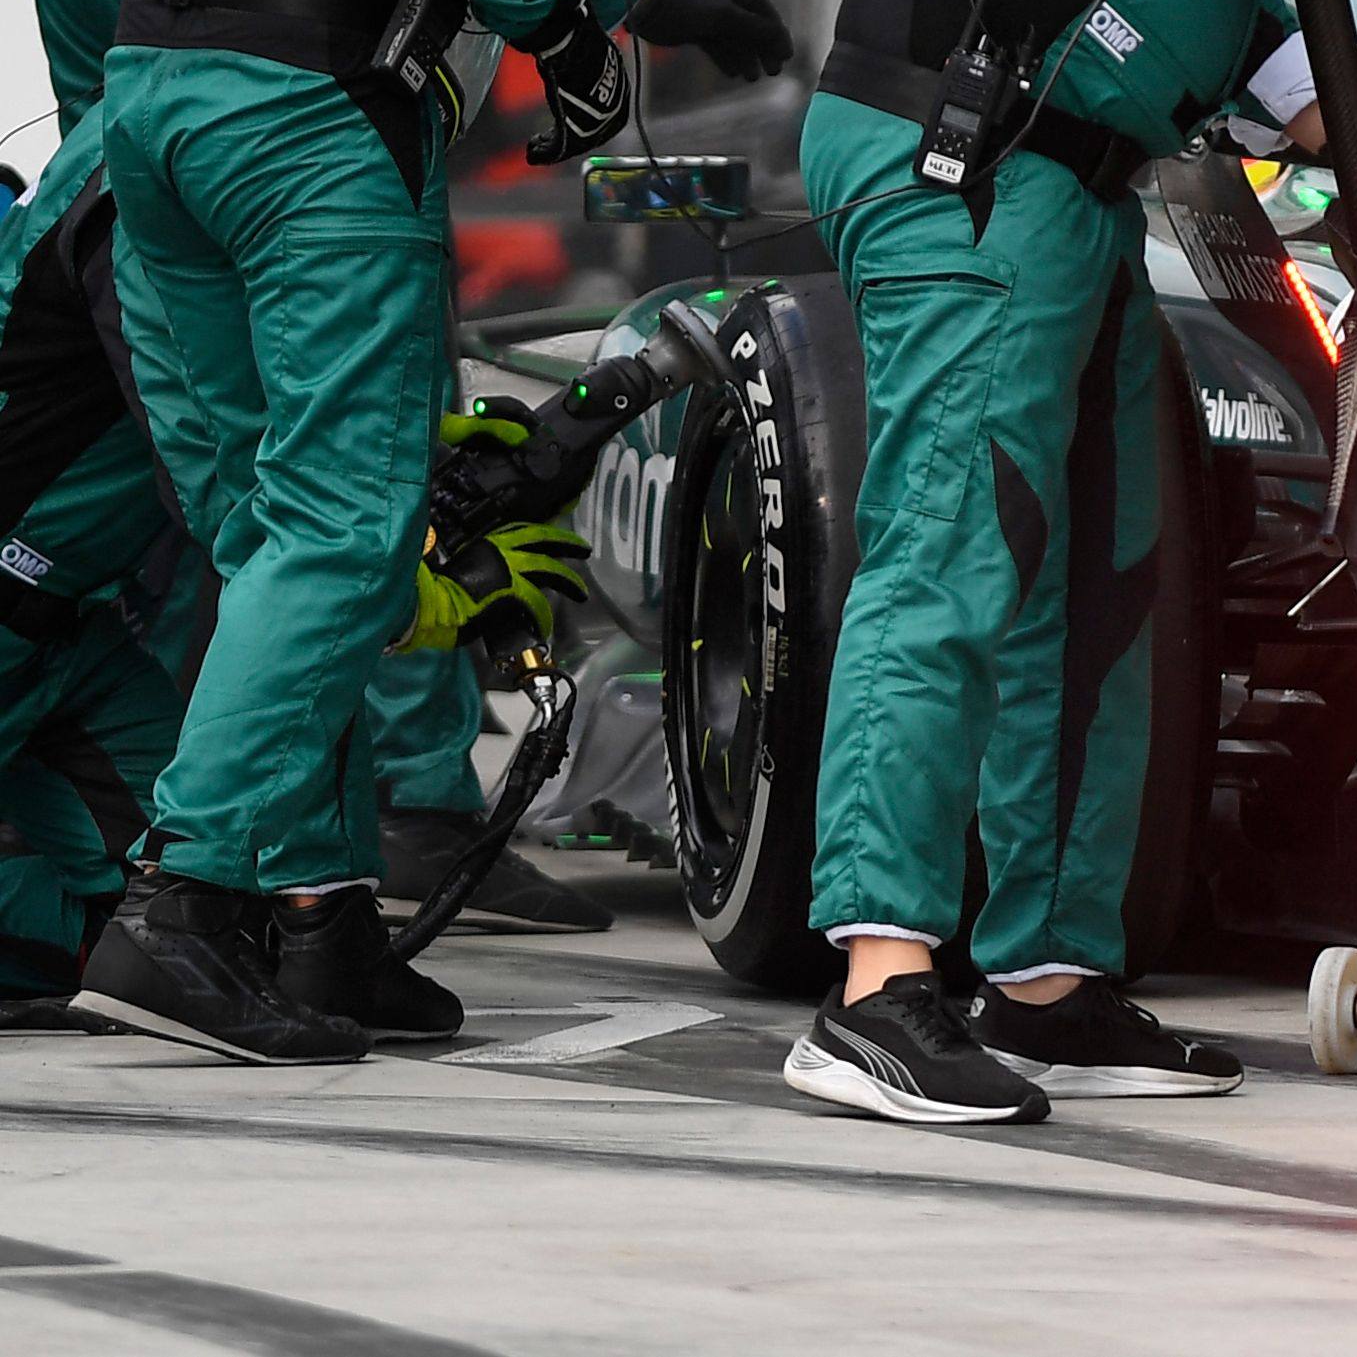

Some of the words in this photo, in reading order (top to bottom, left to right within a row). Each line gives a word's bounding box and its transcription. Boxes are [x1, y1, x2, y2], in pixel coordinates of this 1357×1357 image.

[1091, 8, 1139, 56] OMP
[730, 331, 757, 360] P
[746, 368, 786, 613] ZERO
[1, 540, 50, 584] OMP
